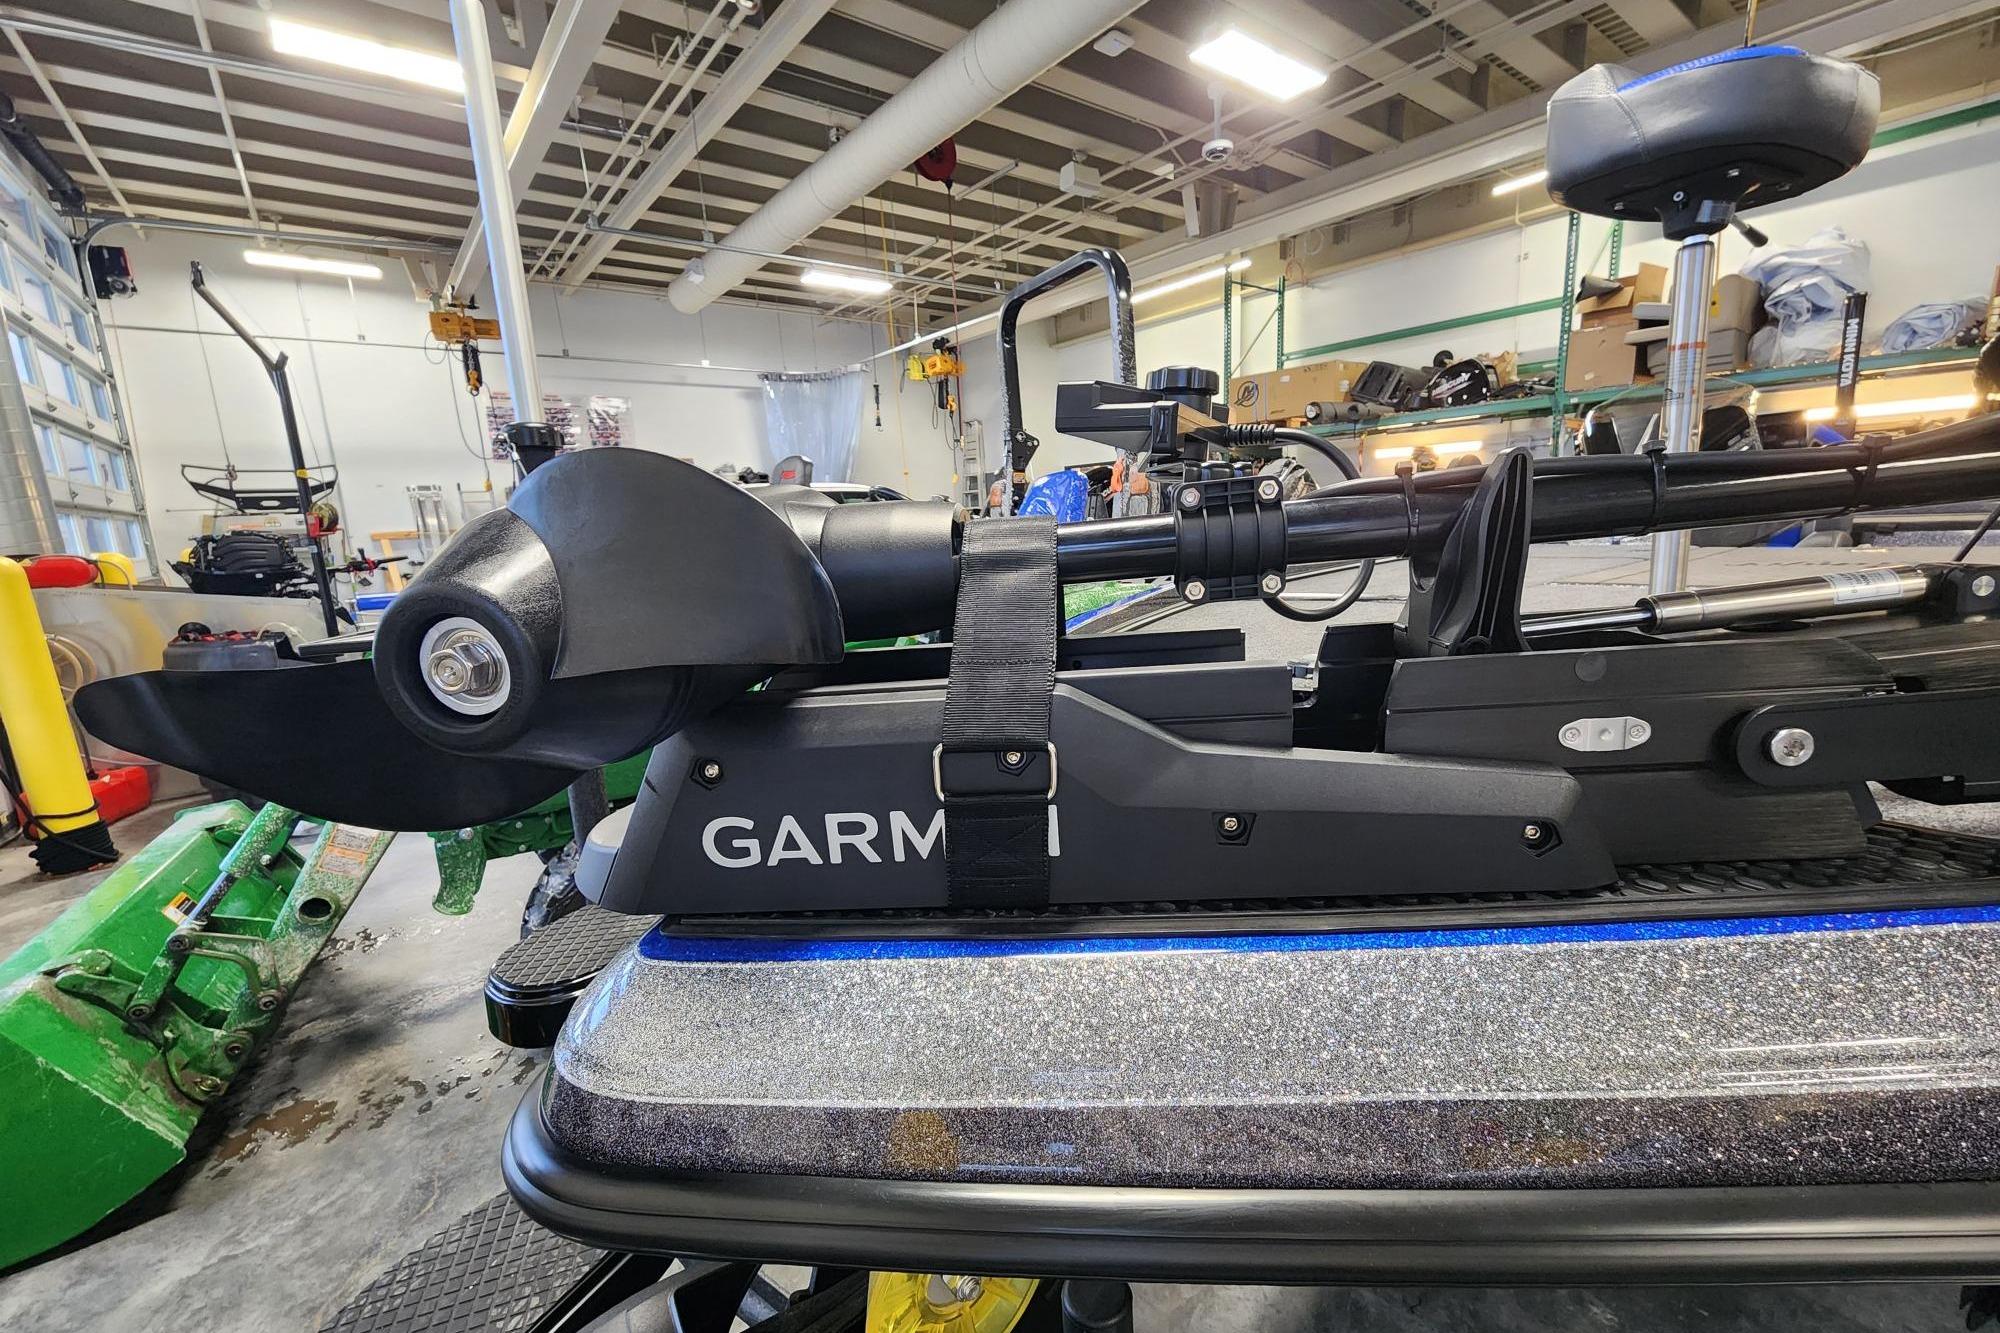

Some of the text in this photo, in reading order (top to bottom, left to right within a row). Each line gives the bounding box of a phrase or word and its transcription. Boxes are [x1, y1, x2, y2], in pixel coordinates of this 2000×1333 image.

[1840, 318, 1859, 387] MINN KOTA
[701, 804, 1061, 868] GARM
